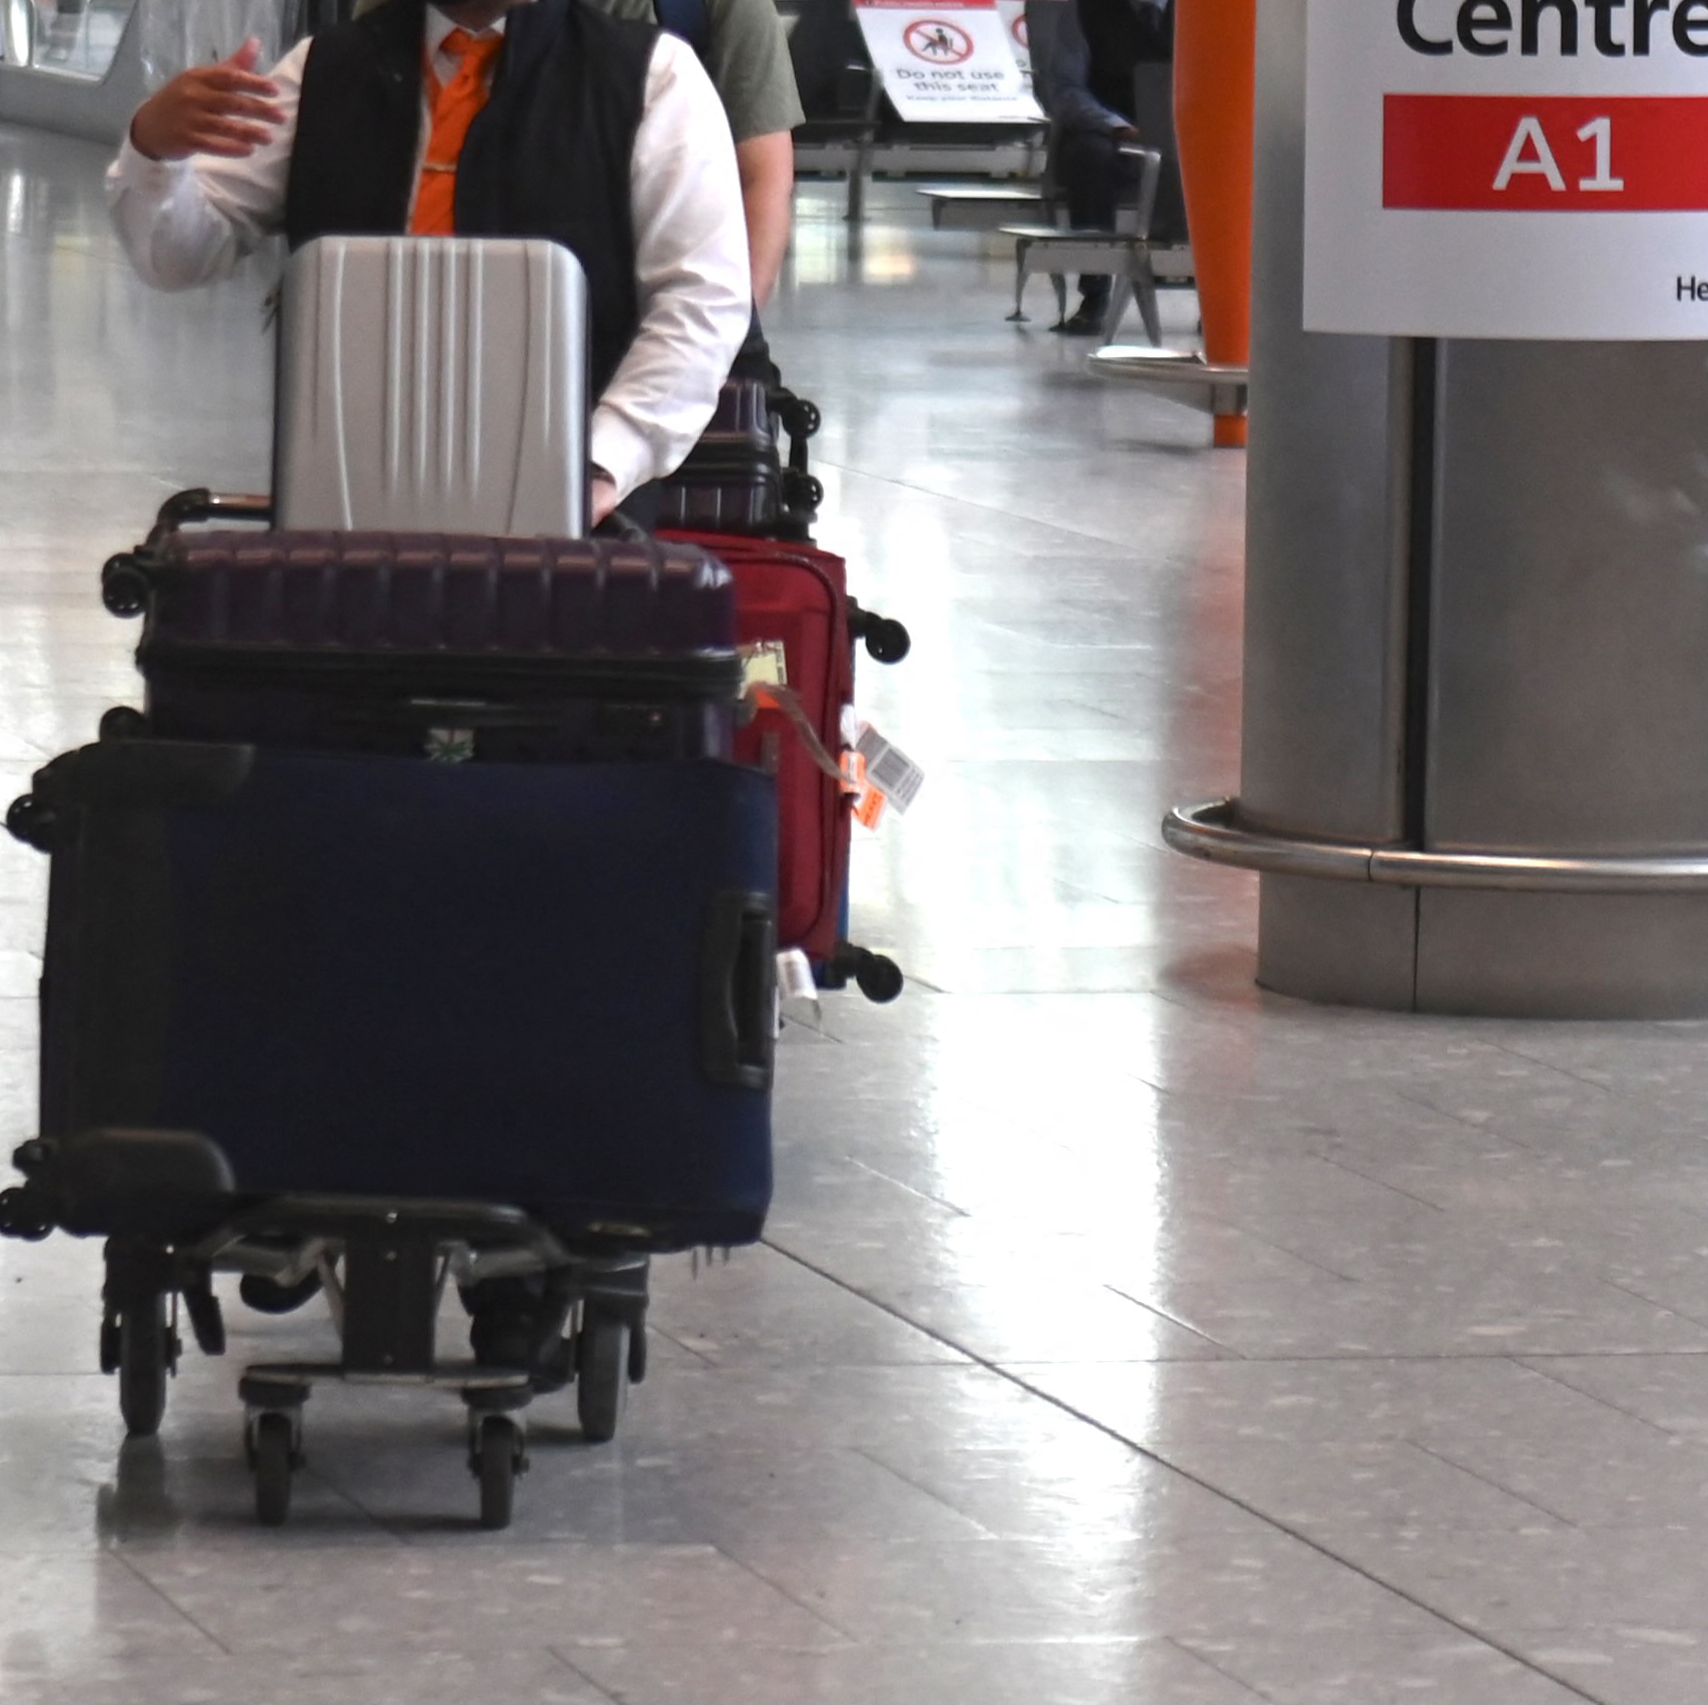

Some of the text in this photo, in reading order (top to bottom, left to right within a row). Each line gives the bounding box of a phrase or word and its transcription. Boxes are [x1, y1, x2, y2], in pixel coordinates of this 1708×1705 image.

[896, 68, 1005, 80] Do not use
[914, 81, 999, 92] this seat
[1492, 116, 1624, 193] A1
